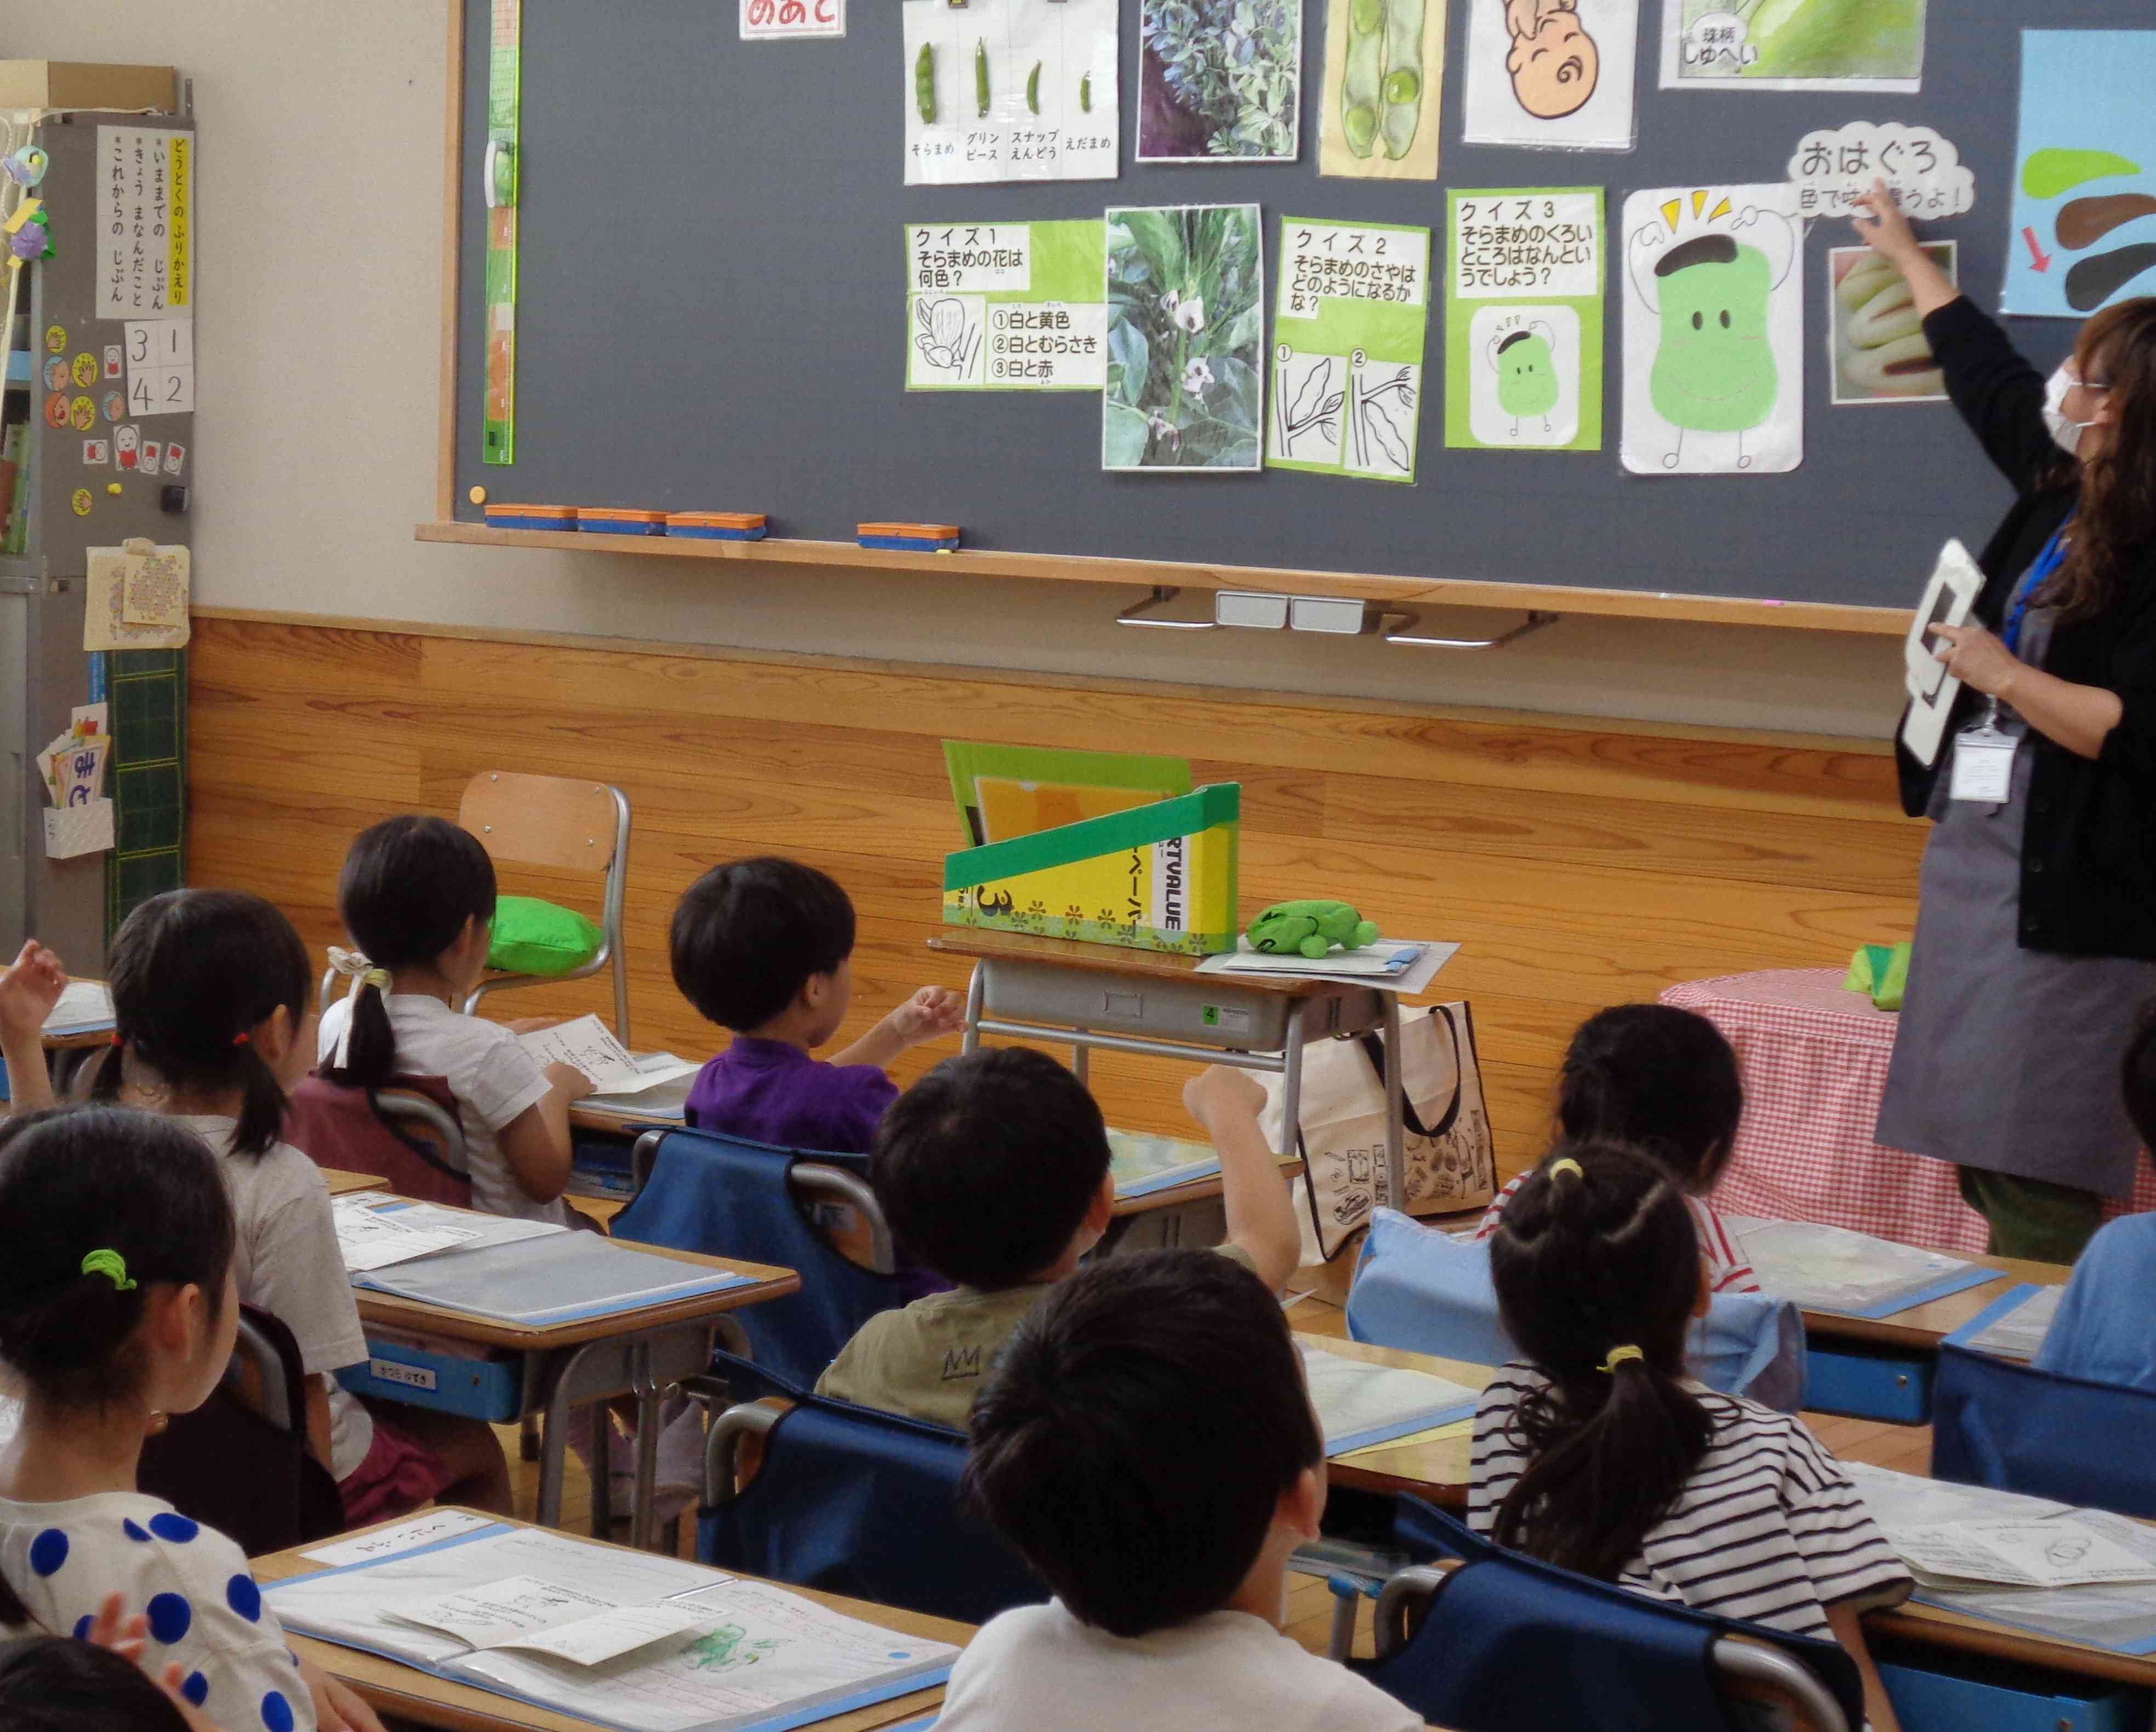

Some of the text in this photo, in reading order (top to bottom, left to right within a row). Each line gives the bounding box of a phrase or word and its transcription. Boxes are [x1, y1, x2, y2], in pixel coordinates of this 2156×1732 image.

[912, 142, 955, 157] そらまめ
[1011, 146, 1057, 160] えんどう
[1065, 137, 1111, 150] えだまめ
[1802, 140, 1937, 175] おはぐろ
[173, 139, 185, 305] どうとくの ふりかえり
[1461, 224, 1593, 245] そらまめのくろい
[132, 205, 145, 307] まなんだこと
[917, 248, 1023, 268] そらまめの花は
[1293, 254, 1417, 284] そらまめのさやは
[1461, 245, 1592, 266] ところはなんとい
[111, 250, 124, 302] じぶん
[152, 258, 164, 310] じぶん
[919, 269, 963, 288] 何色？
[1291, 272, 1411, 303] どのようになるか
[1461, 266, 1552, 287] うでしょう？
[1290, 292, 1319, 312] な？
[132, 329, 149, 362] 3
[172, 328, 176, 354] 1
[133, 377, 154, 411] 4
[166, 375, 184, 402] 2
[977, 885, 1013, 917] 3
